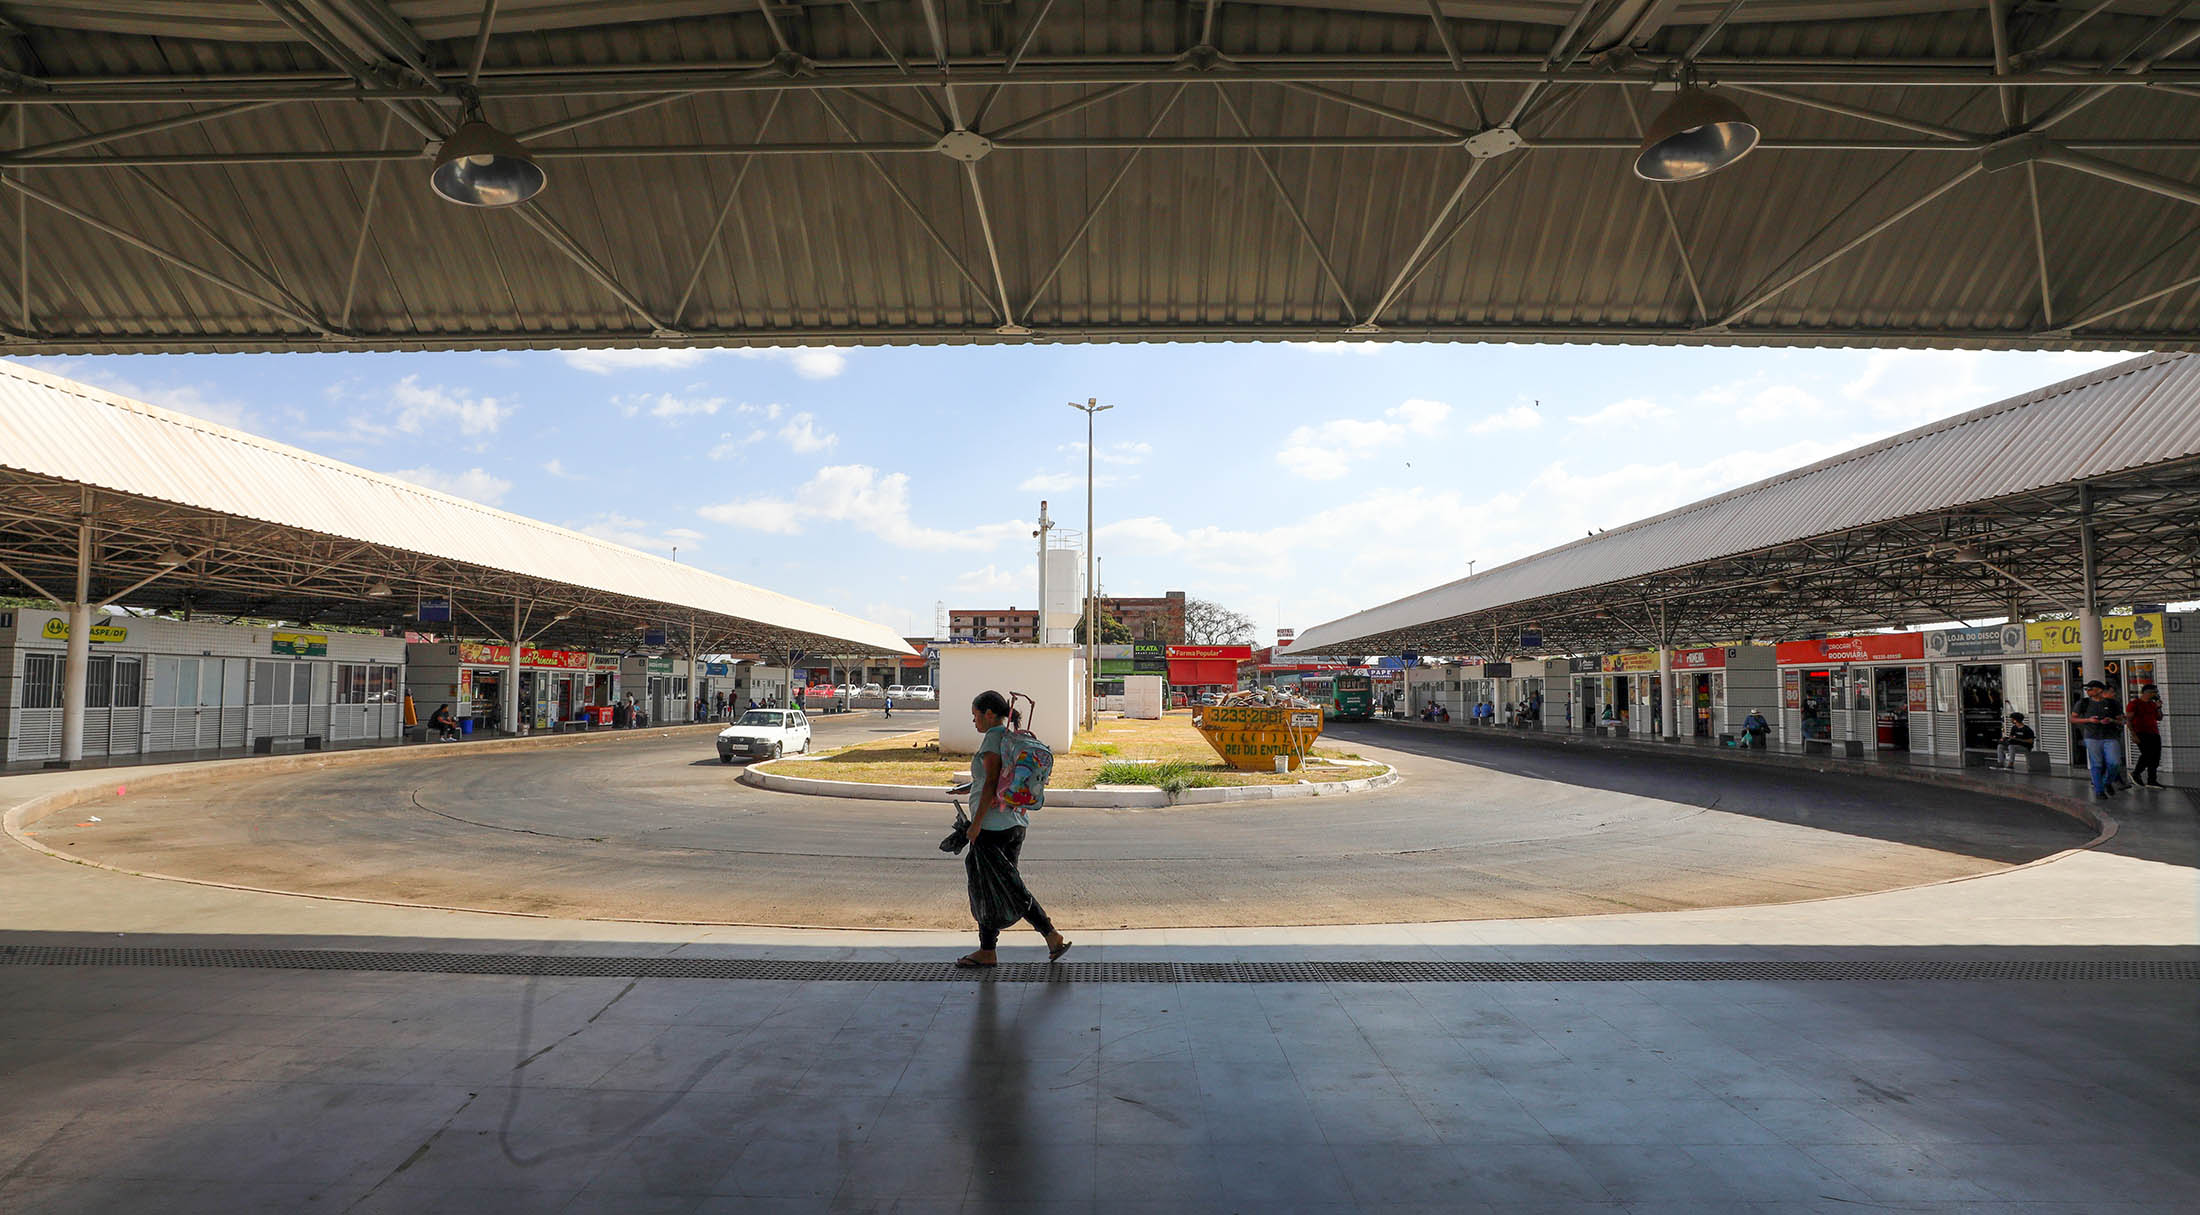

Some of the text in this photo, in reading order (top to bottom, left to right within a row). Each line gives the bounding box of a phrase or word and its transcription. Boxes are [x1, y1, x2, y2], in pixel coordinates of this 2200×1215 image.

[2171, 619, 2180, 630] D
[64, 626, 124, 637] CASPE/DF
[1947, 634, 1965, 642] LOJA
[1978, 631, 2000, 640] DISCO
[2062, 624, 2133, 644] Cheiro
[1828, 650, 1868, 659] RODOVIÁRIA
[1786, 689, 1798, 700] 80
[1910, 689, 1925, 702] 80
[1225, 744, 1240, 755] REI
